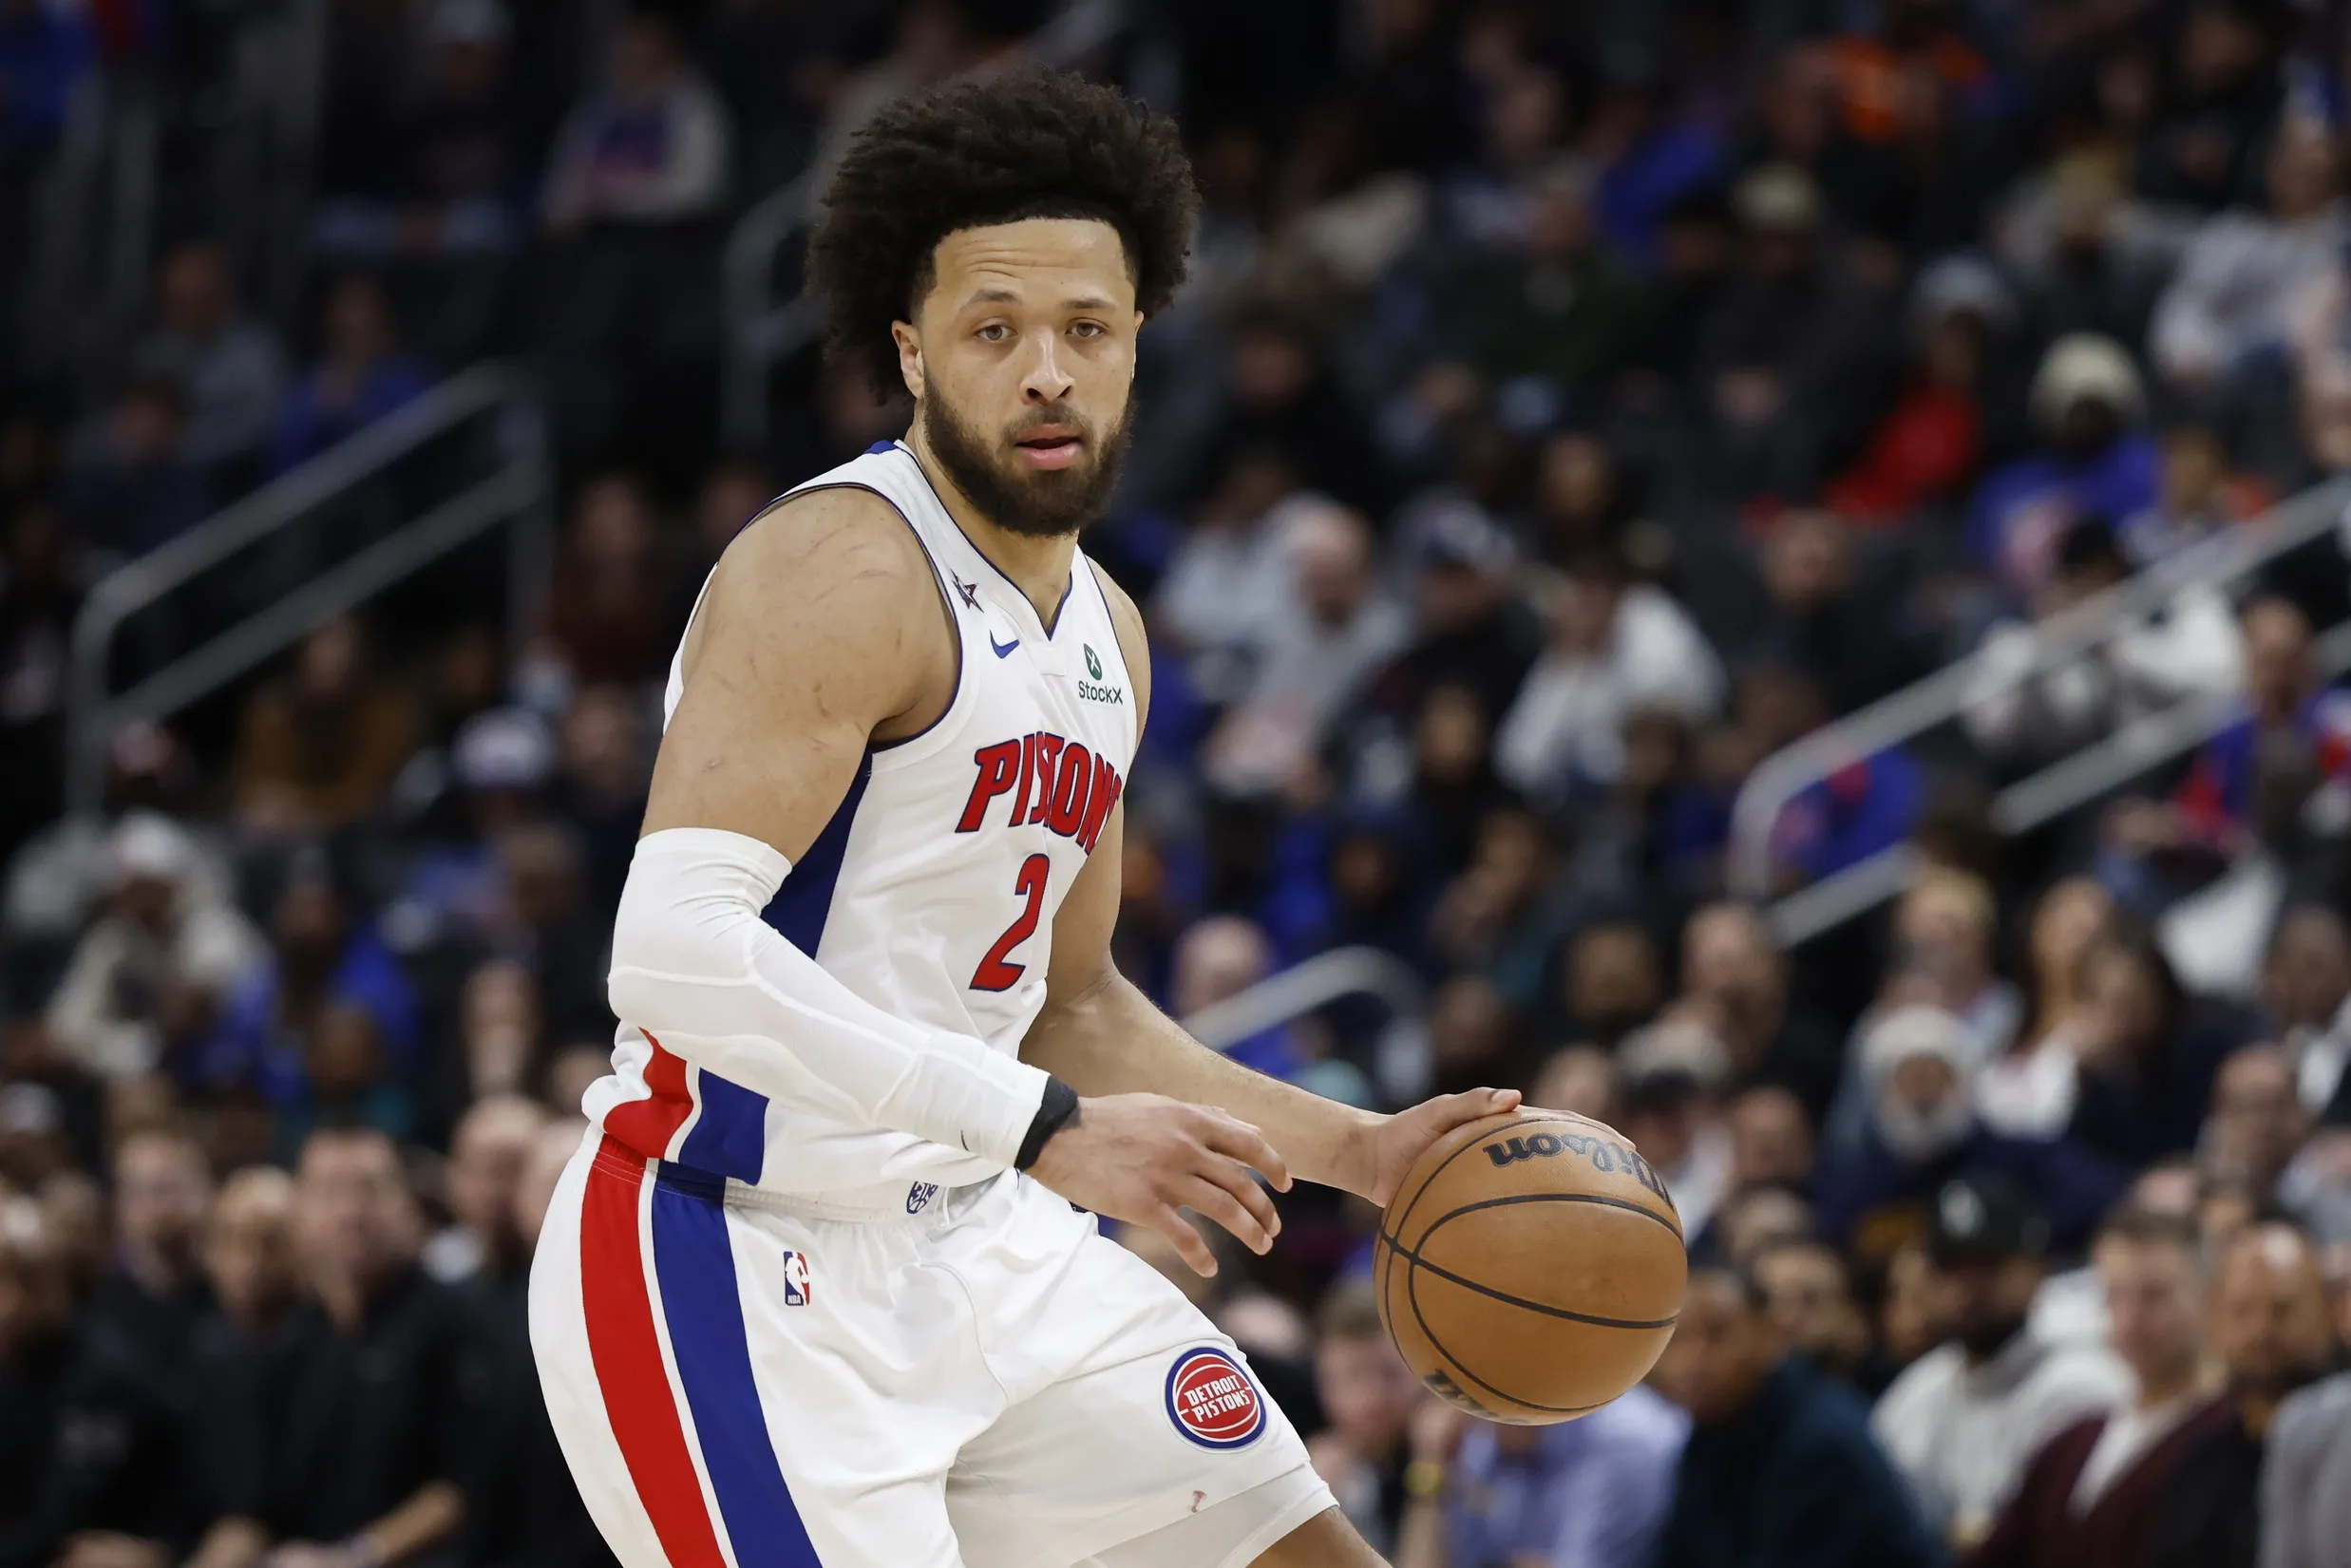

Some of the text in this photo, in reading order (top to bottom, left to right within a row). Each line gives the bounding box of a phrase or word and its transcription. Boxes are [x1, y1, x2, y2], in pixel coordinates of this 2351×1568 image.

[1078, 680, 1123, 705] StockX
[969, 853, 1050, 992] 2
[1483, 1132, 1677, 1213] Wilson
[787, 1294, 802, 1305] NBA
[1184, 1374, 1241, 1407] DETROIT
[1191, 1389, 1251, 1423] PISTONS
